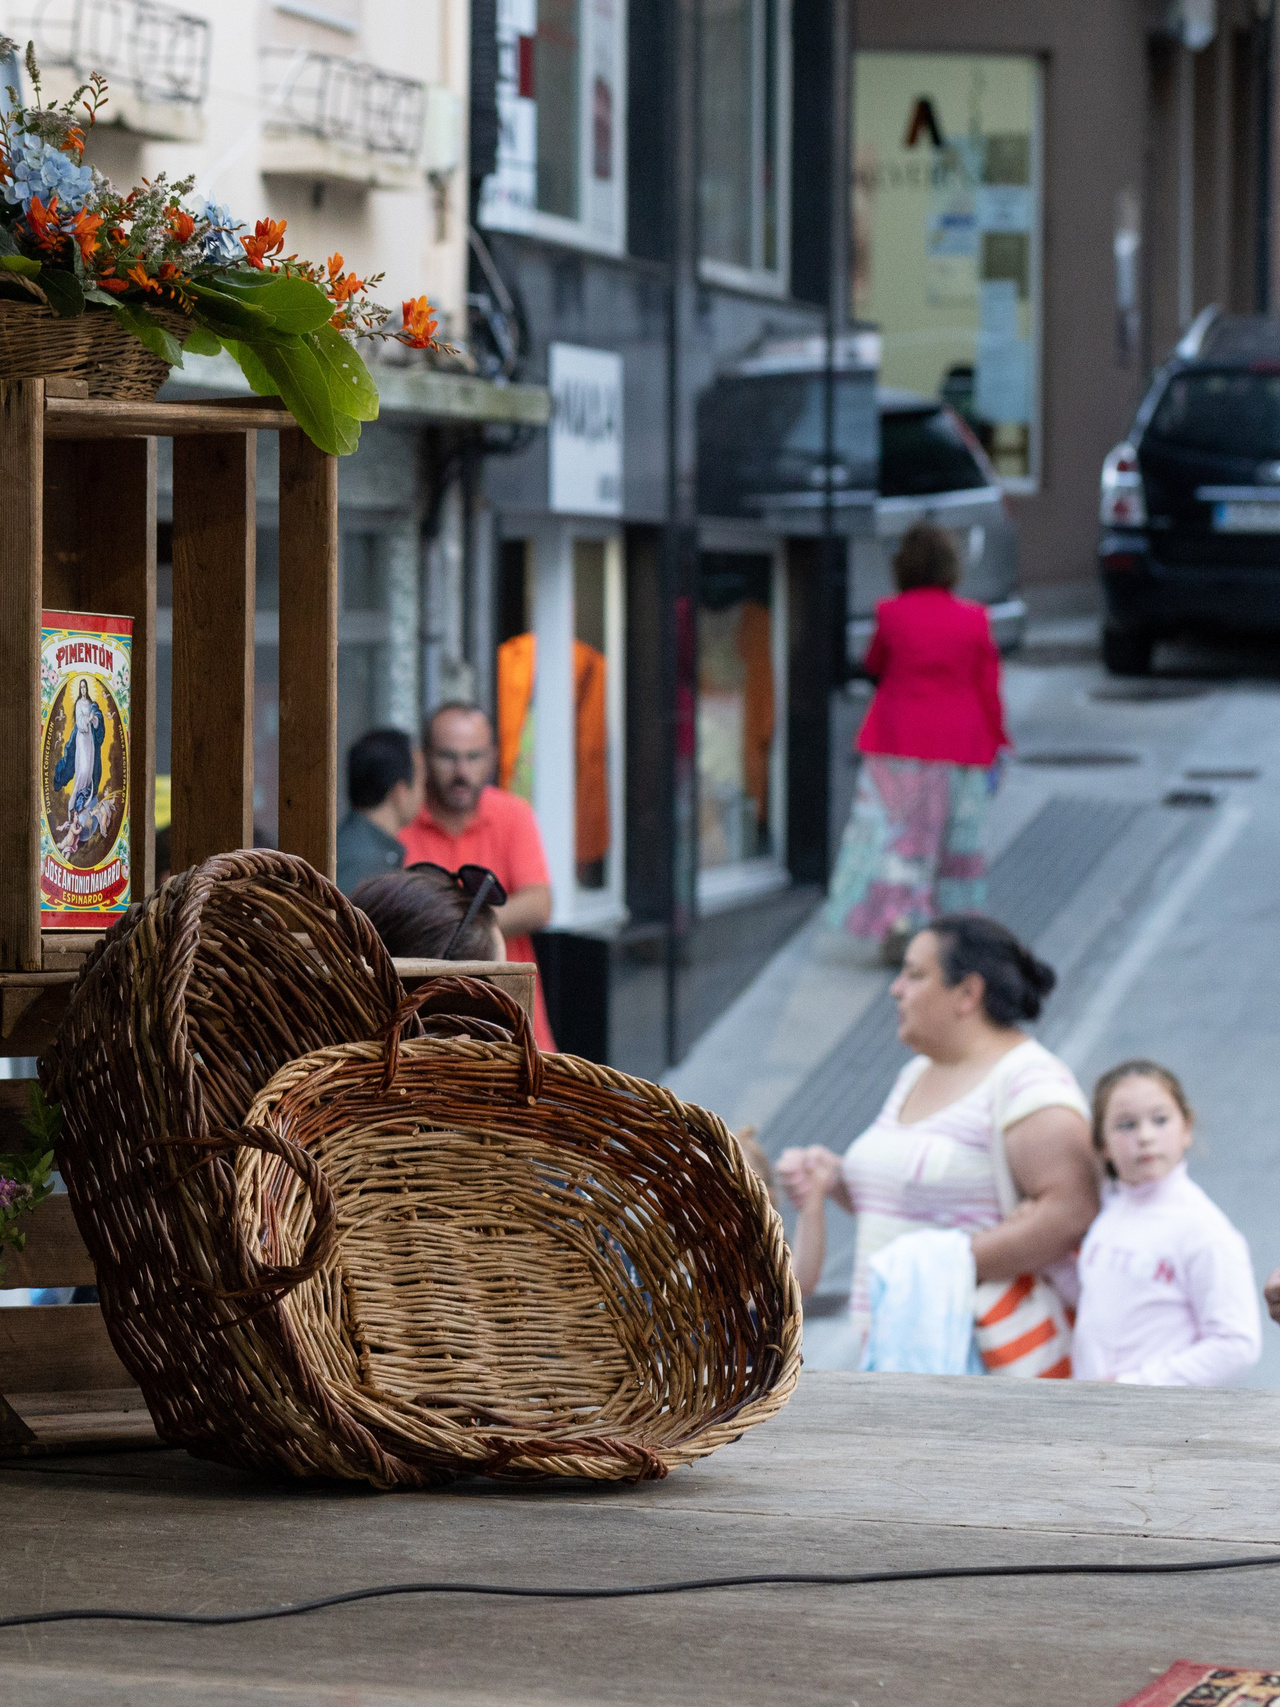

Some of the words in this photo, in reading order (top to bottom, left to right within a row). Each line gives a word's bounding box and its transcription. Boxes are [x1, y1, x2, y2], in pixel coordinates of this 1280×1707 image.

[55, 642, 113, 673] PIMENTÓN
[61, 868, 90, 894] ANTONIO
[90, 859, 121, 893] NAVARRO
[62, 890, 103, 905] ESPINARDO
